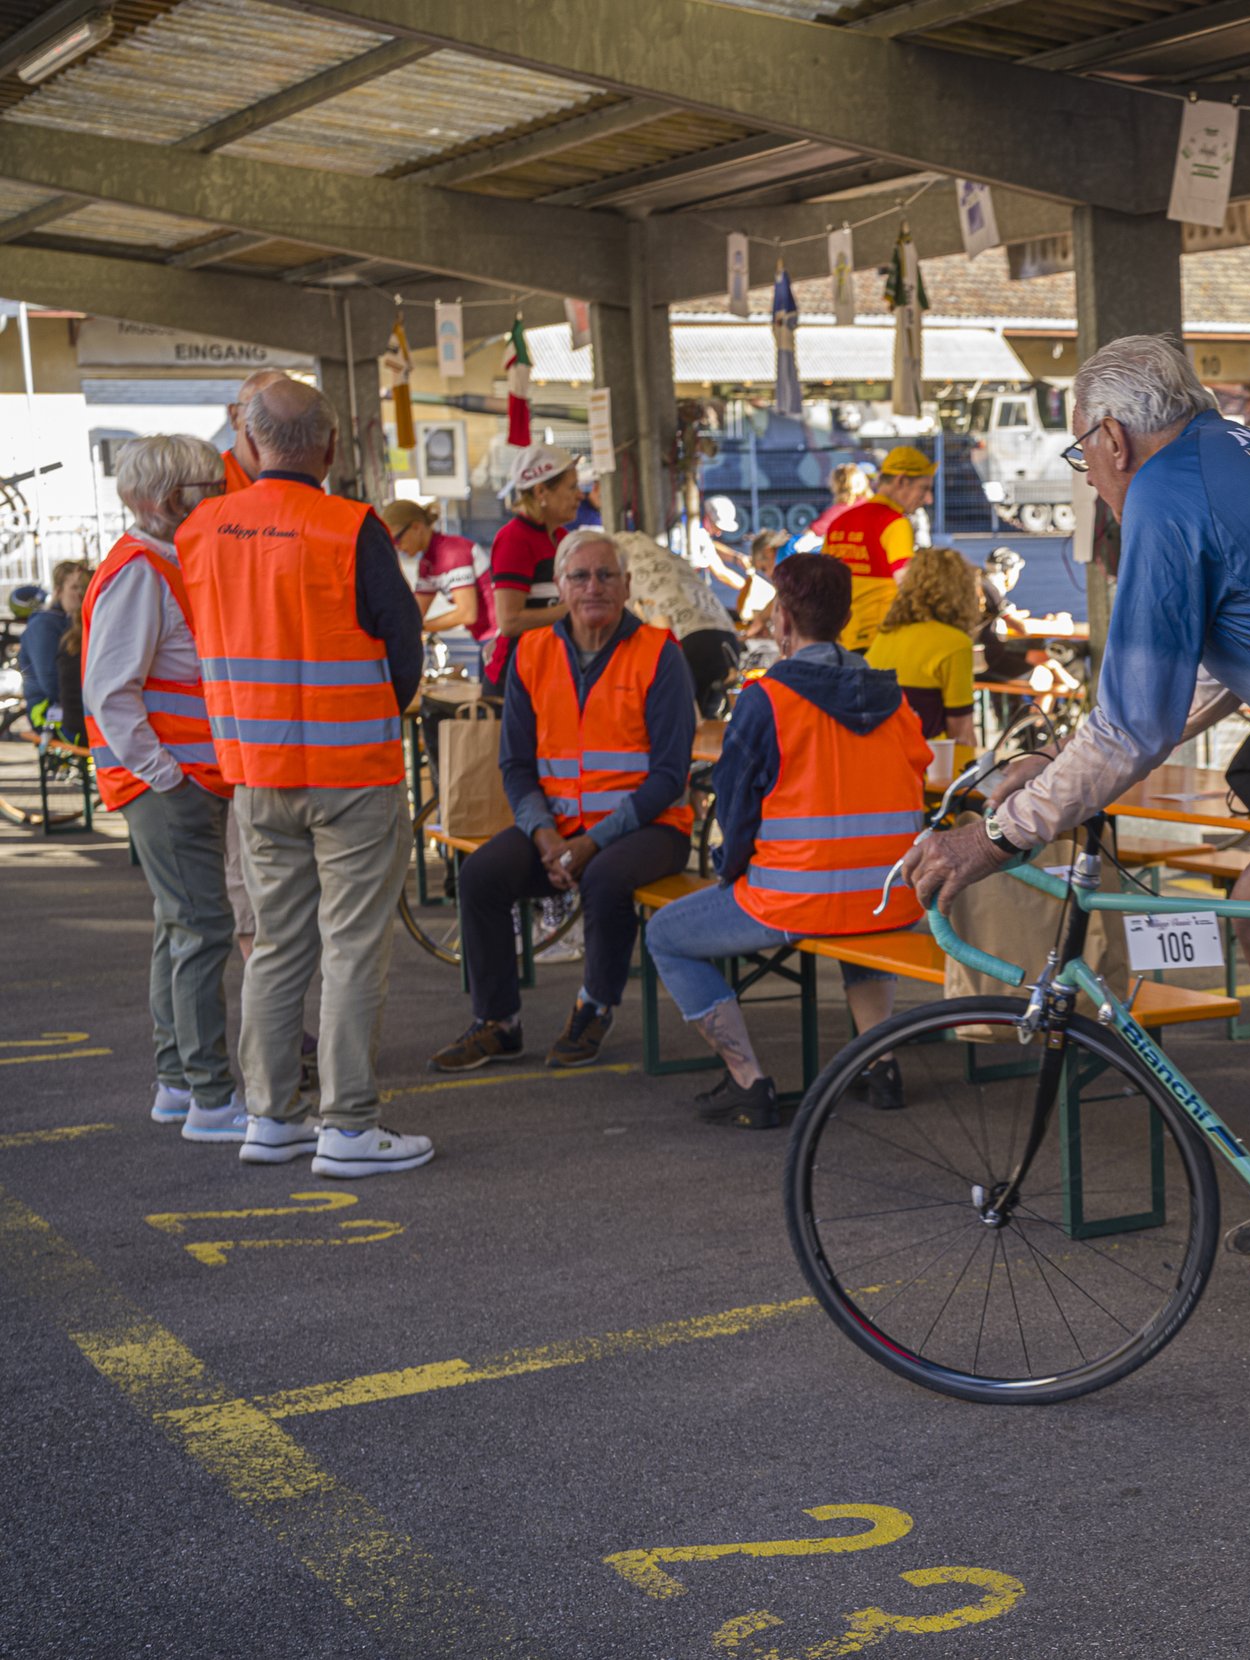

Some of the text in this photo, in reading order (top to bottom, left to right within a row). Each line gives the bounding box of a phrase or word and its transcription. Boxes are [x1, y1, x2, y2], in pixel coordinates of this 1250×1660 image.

[174, 343, 267, 361] EINGANG
[1157, 931, 1195, 963] 106
[1122, 1021, 1213, 1122] Bianchi
